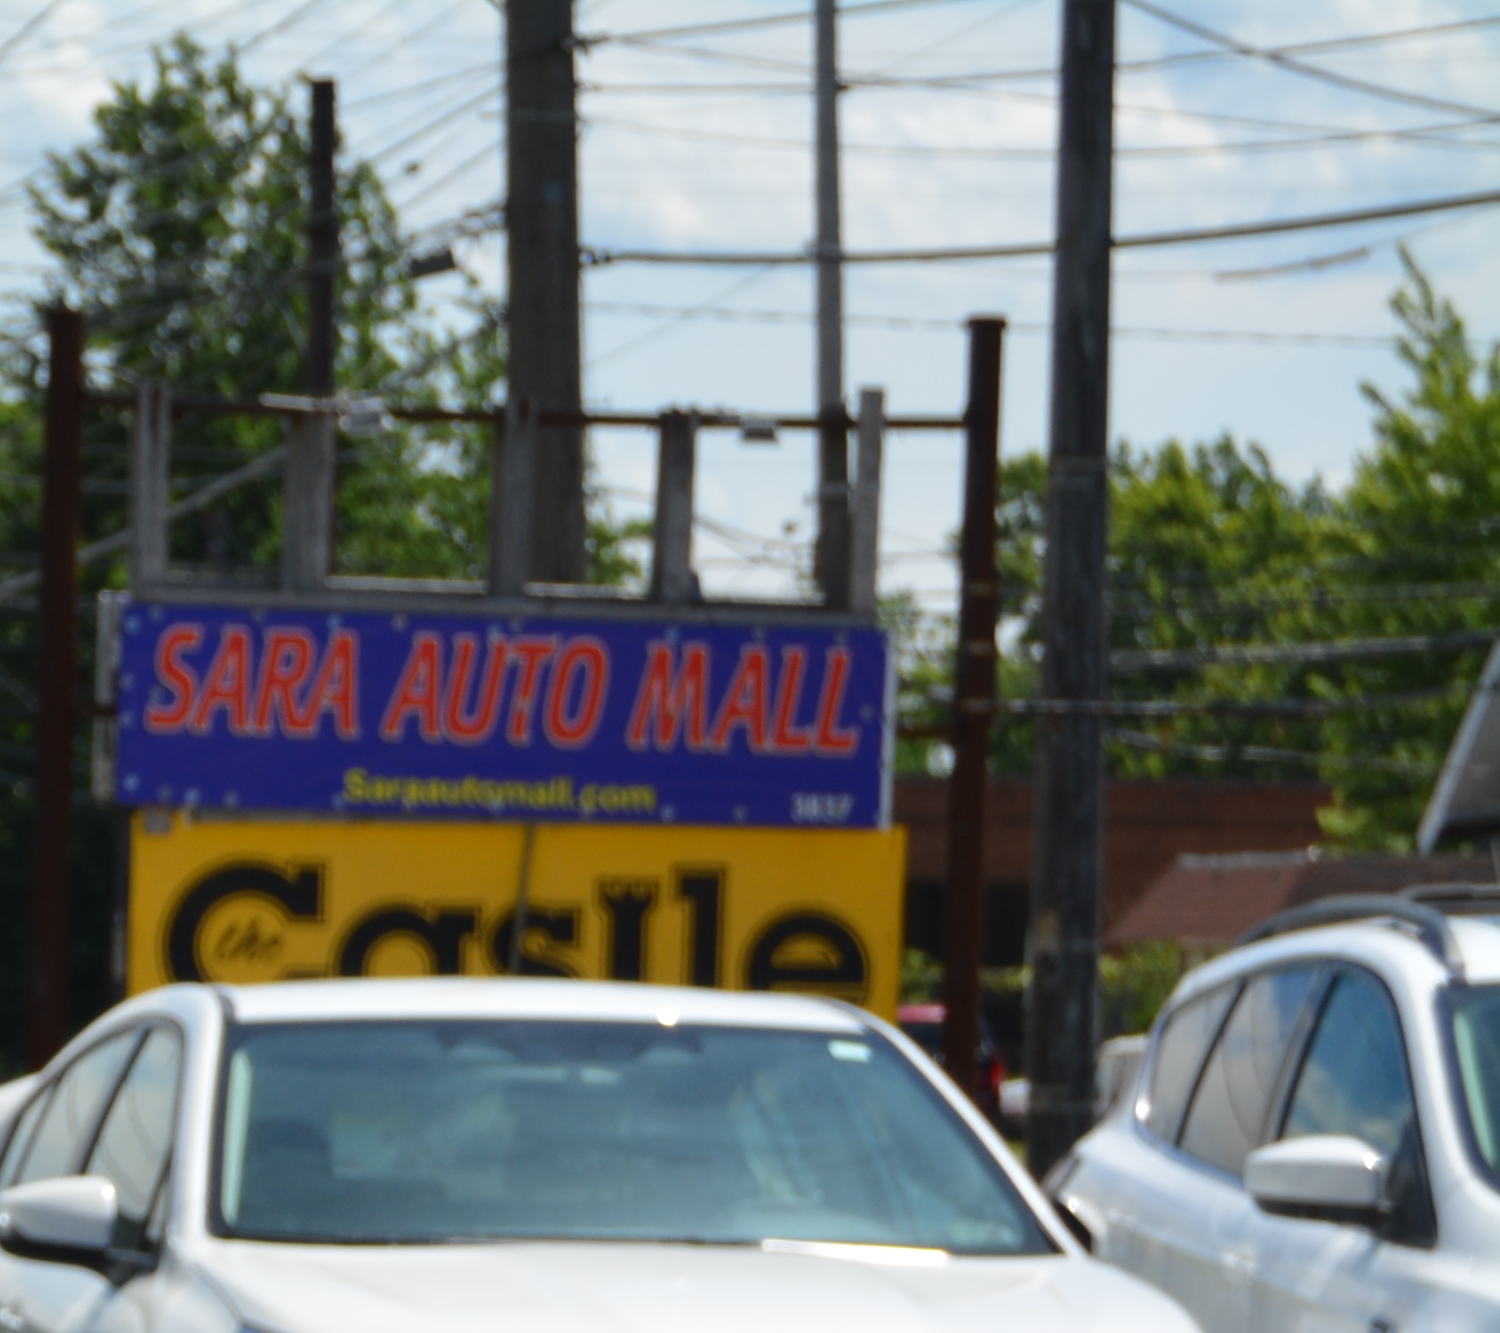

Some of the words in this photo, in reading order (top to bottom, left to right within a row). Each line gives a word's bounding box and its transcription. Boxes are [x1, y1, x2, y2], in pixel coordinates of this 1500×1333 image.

[145, 624, 361, 742] SARA
[380, 631, 609, 749] AUTO
[626, 640, 858, 756] MALL
